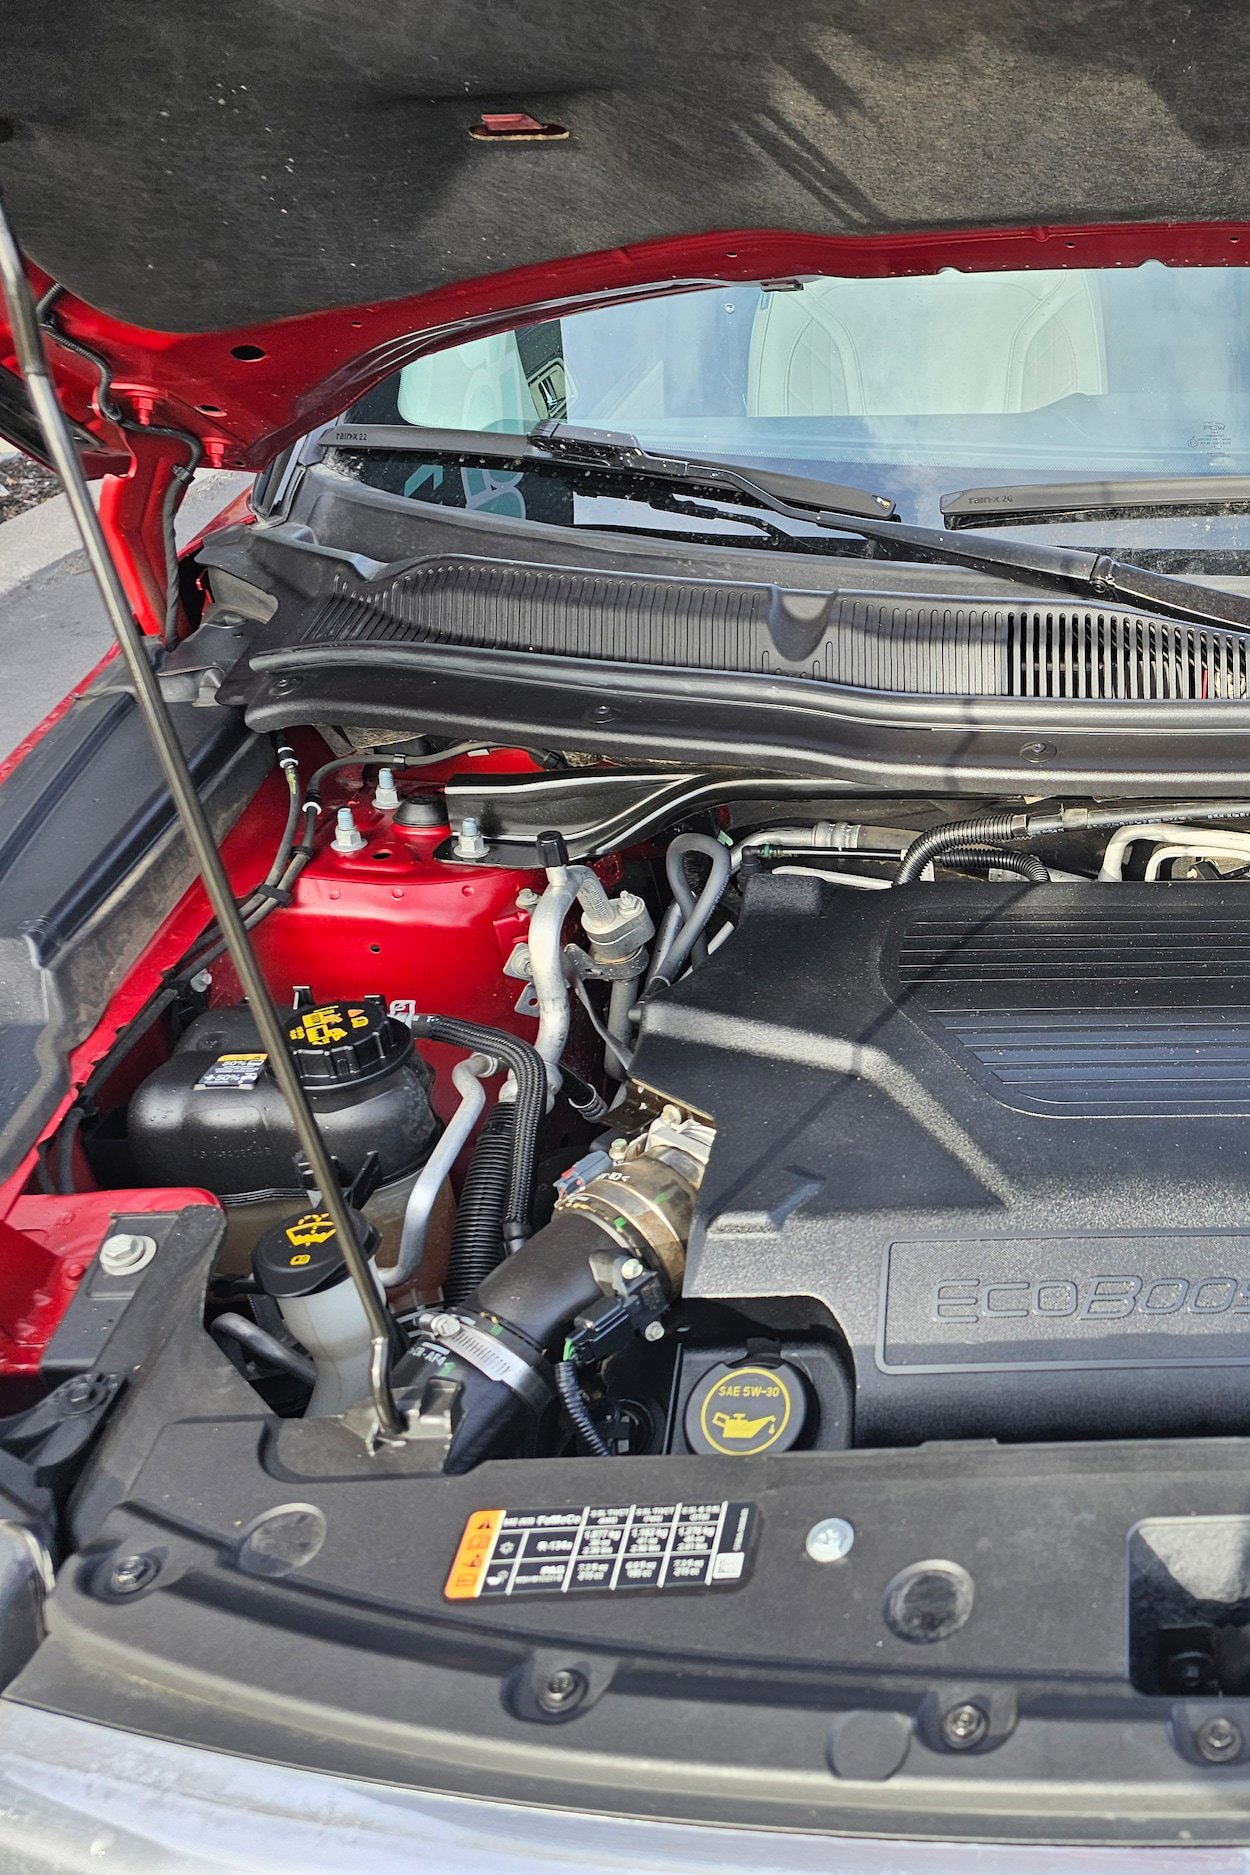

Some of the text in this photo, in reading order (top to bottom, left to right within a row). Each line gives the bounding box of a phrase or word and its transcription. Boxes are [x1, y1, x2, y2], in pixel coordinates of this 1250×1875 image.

[359, 432, 368, 441] 22
[719, 1385, 780, 1398] SAE 5W-30
